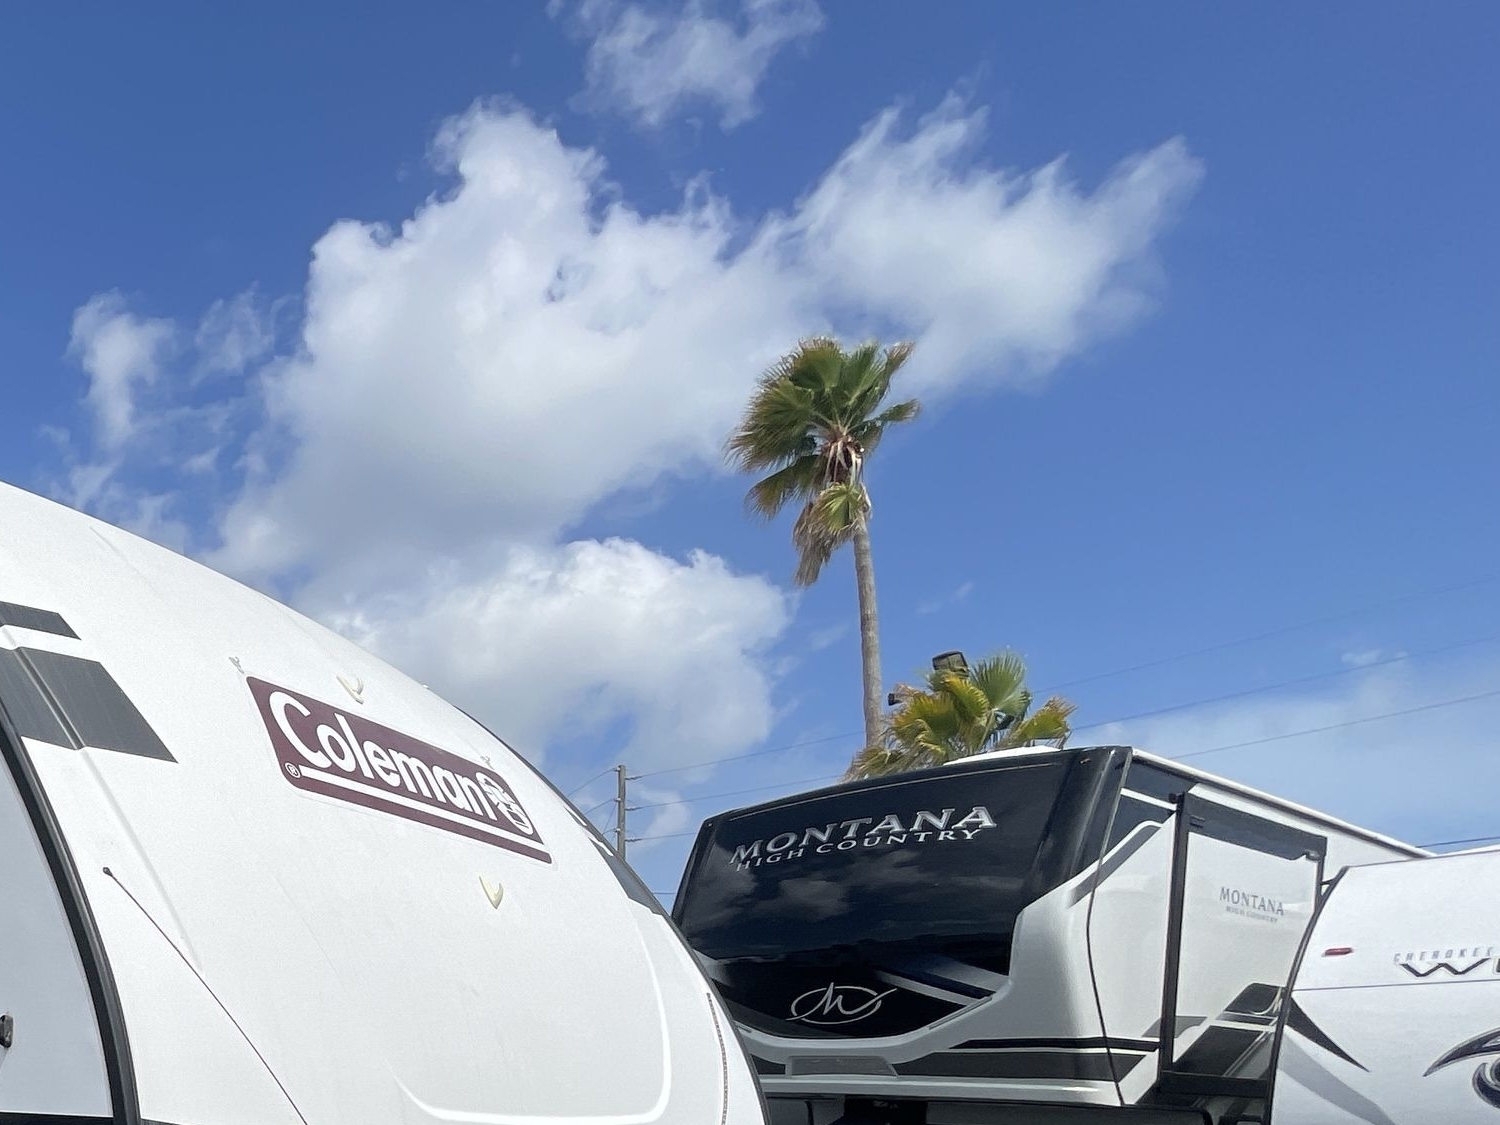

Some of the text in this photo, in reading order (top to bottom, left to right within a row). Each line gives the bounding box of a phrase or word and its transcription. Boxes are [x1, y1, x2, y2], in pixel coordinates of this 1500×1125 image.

[269, 691, 498, 821] Coleman
[729, 806, 998, 864] MONTANA
[736, 829, 981, 872] HIGH COUNTRY
[1219, 886, 1284, 917] MONTANA
